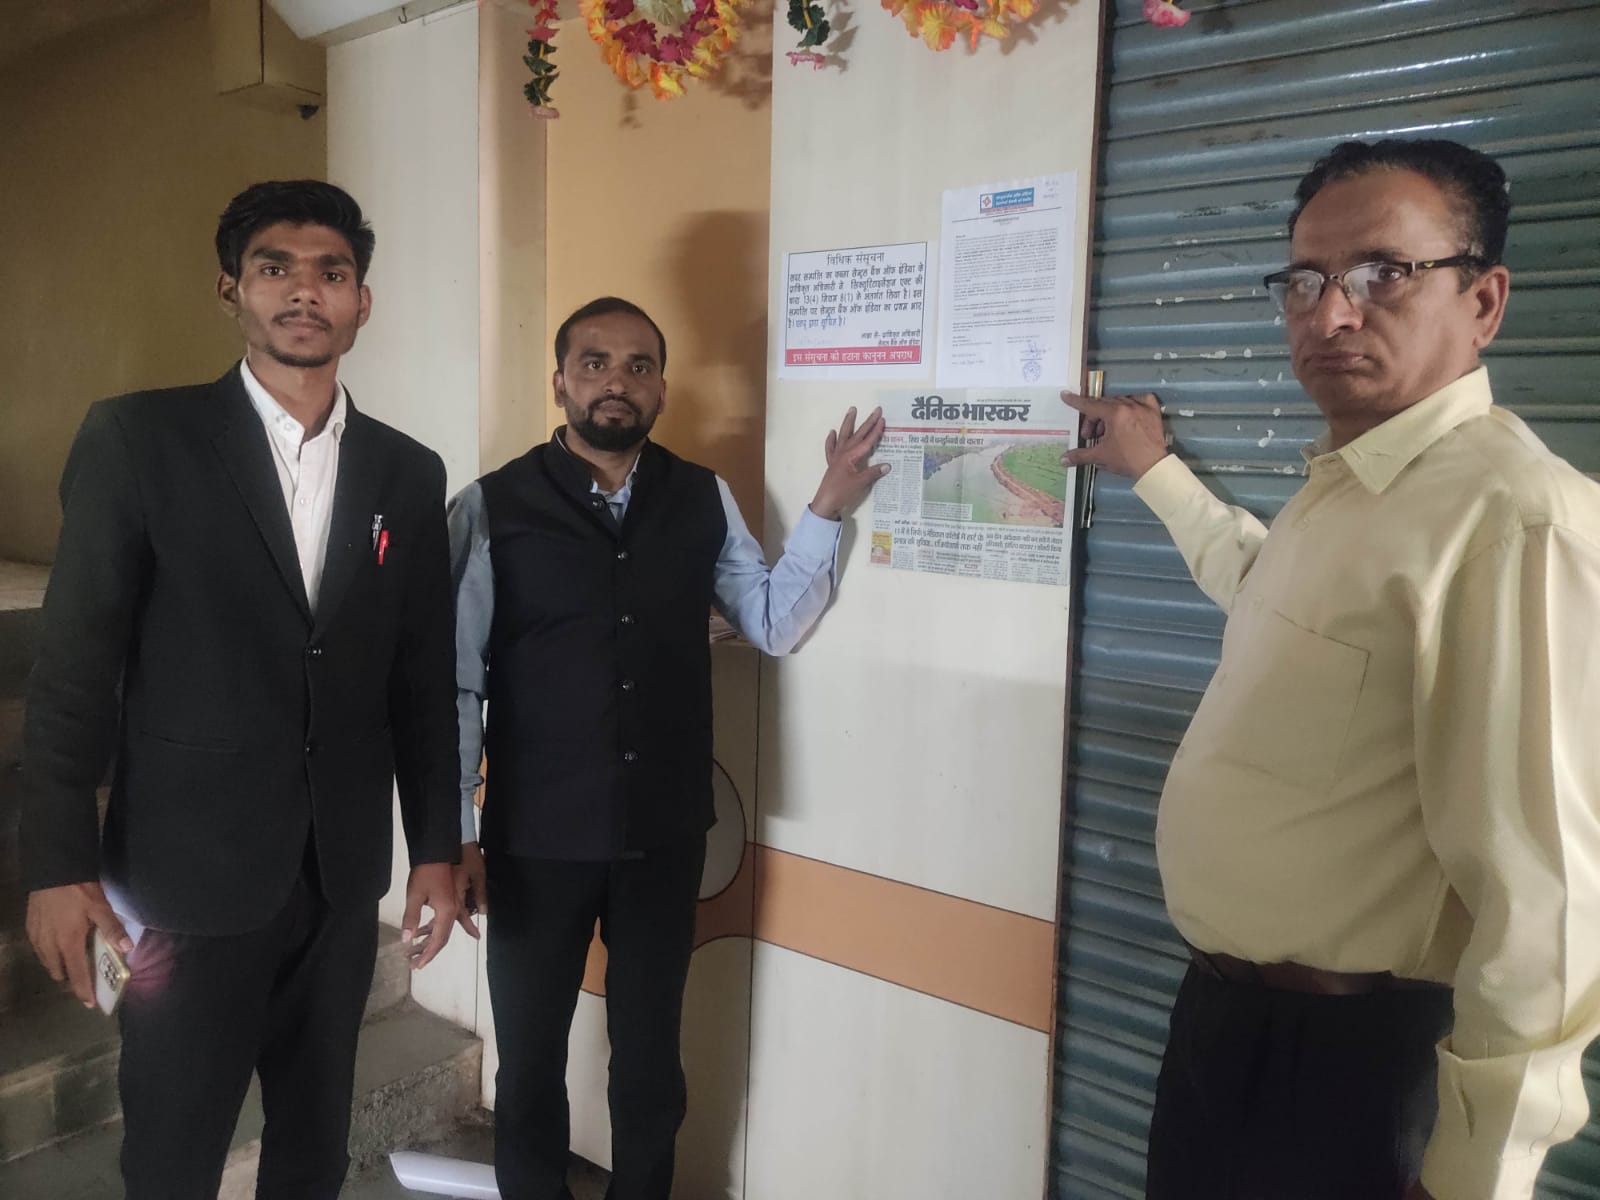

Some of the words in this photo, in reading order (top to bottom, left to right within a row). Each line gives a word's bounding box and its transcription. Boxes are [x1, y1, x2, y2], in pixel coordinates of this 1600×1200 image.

[827, 252, 852, 266] विधिक
[856, 250, 884, 265] संसूचना
[803, 294, 819, 305] 13(4)
[792, 353, 803, 364] इस
[841, 352, 861, 362] हटाना
[889, 350, 913, 362] अपराध
[911, 395, 960, 420] दैनिक
[962, 402, 1031, 422] भास्कर
